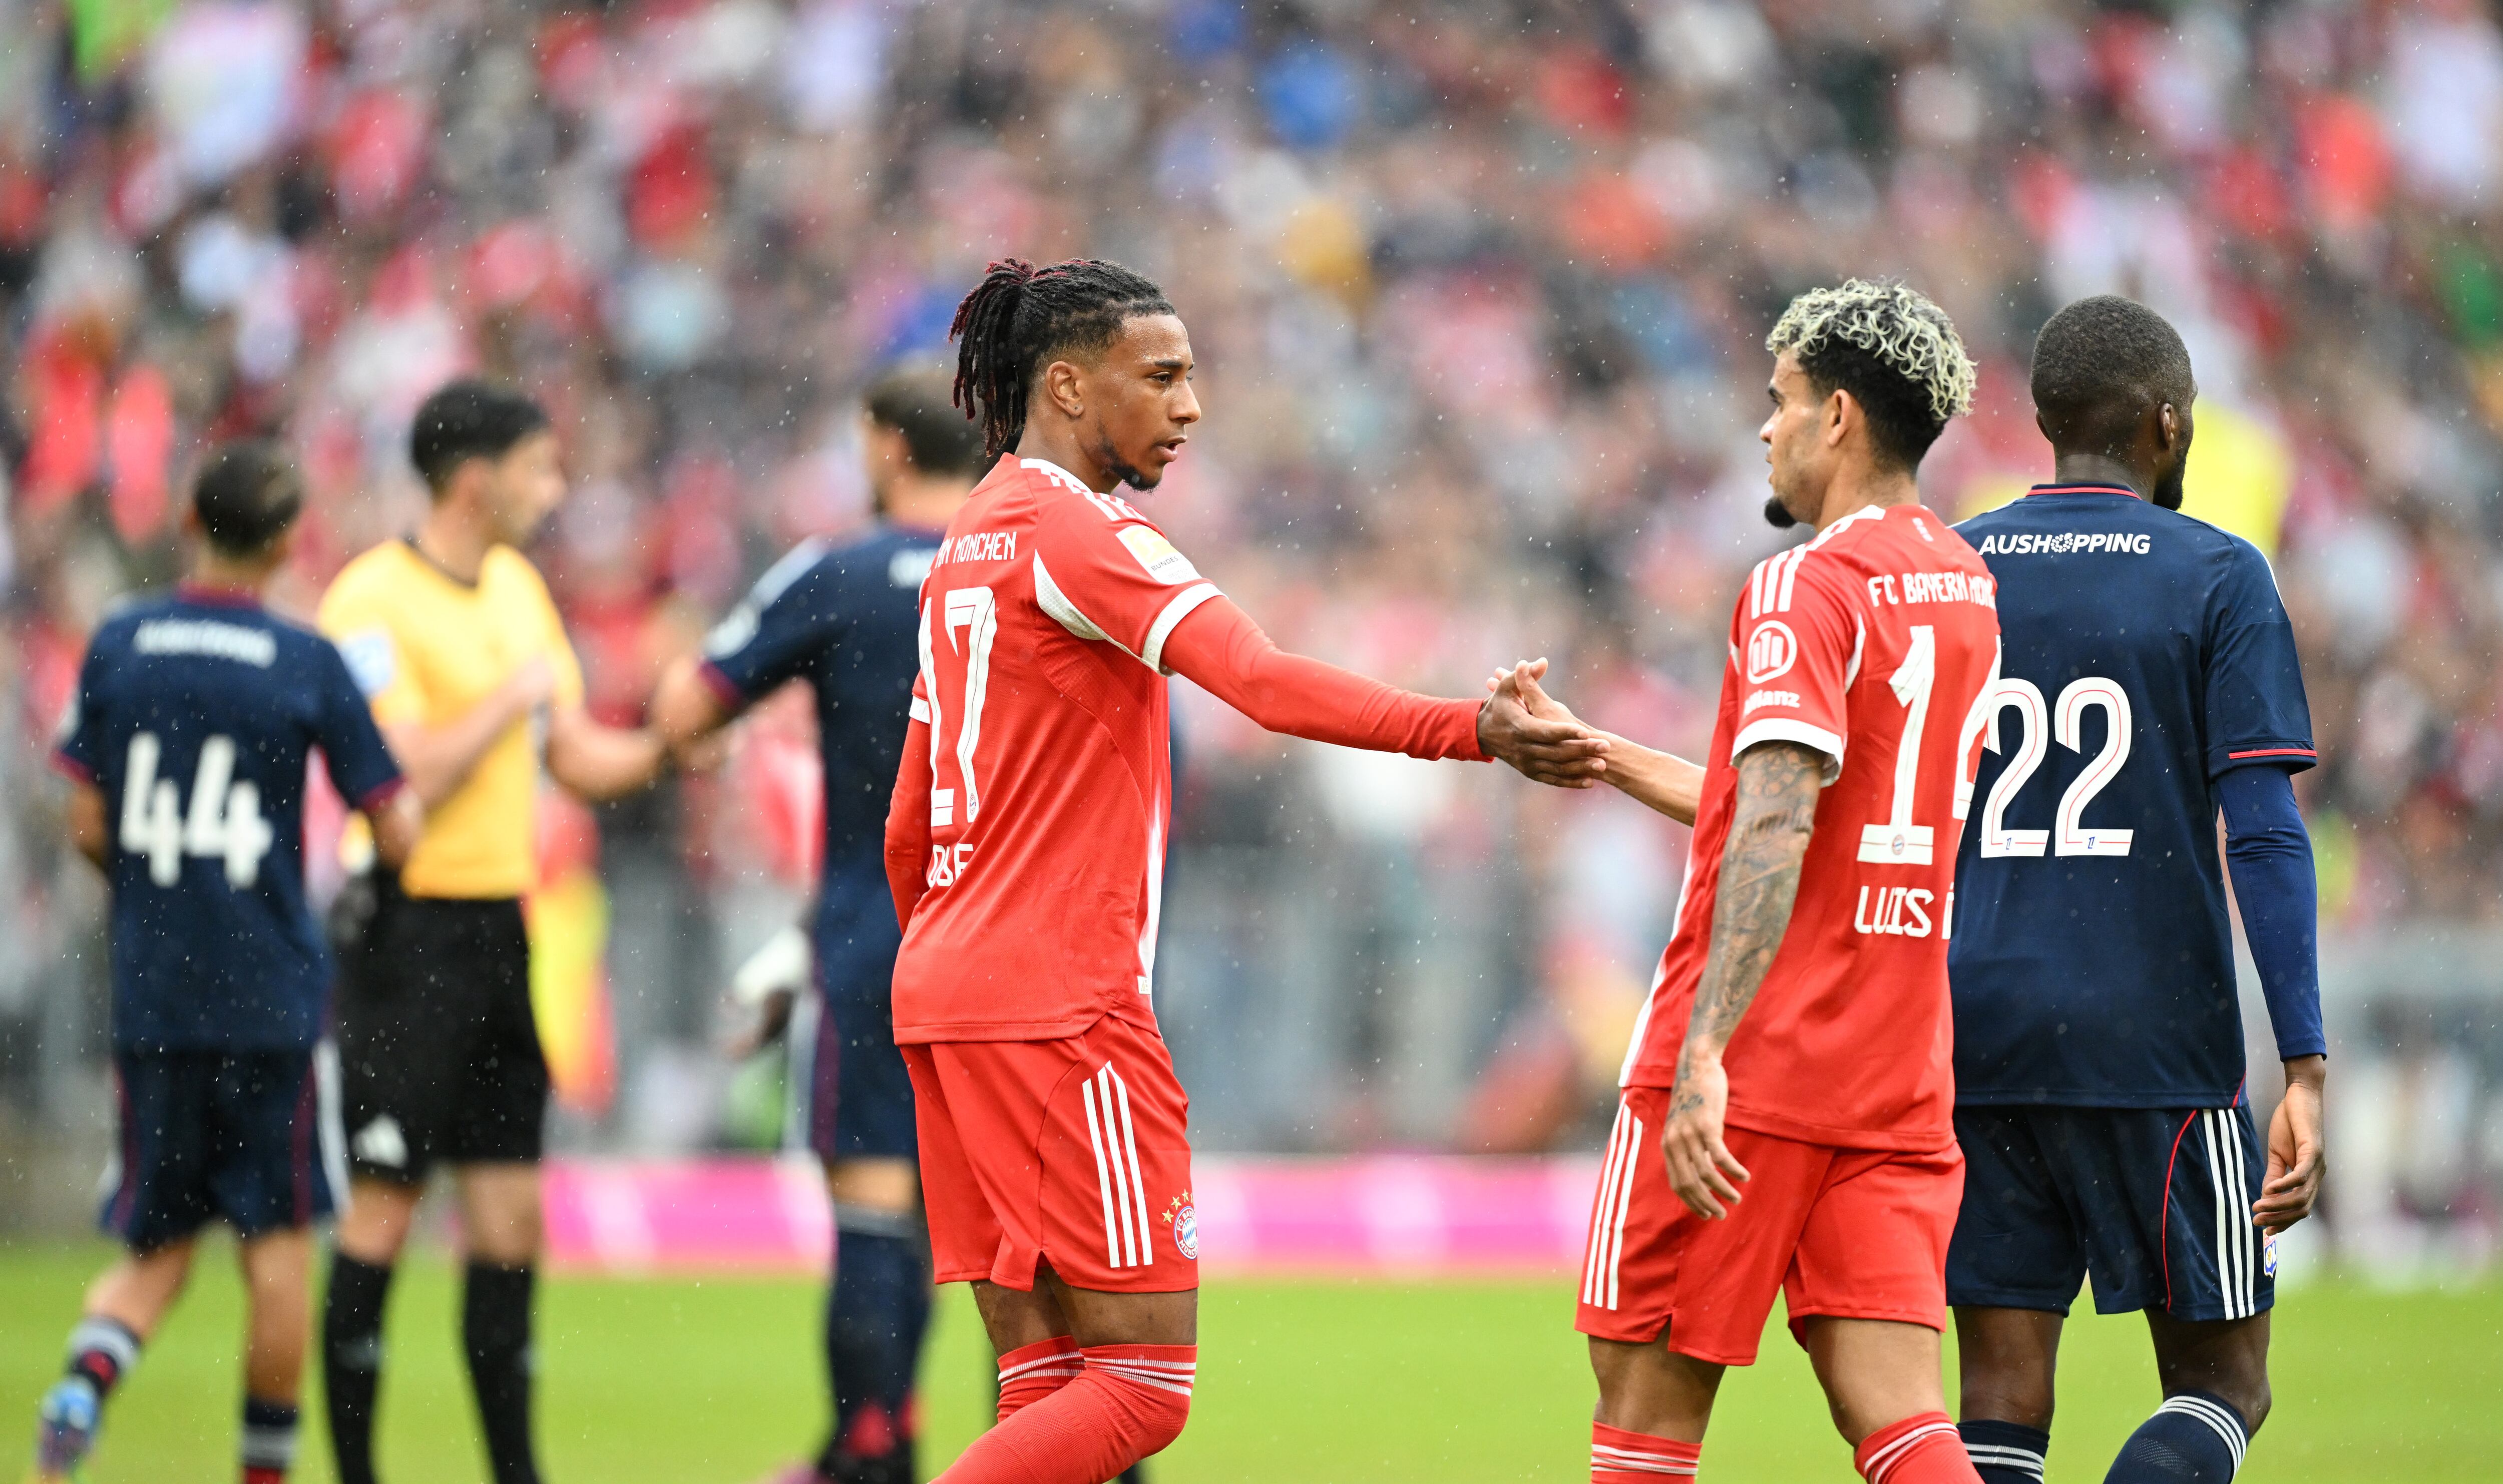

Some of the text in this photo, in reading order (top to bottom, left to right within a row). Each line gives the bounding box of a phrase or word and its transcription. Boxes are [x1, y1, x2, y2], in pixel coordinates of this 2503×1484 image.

[1151, 556, 1179, 571] BUNDES
[1978, 532, 2151, 556] AUSHOPPING
[1867, 575, 1899, 607] FC
[1902, 571, 1970, 604] BAYERN
[918, 586, 996, 826] 17
[1980, 677, 2134, 858] 22
[119, 731, 274, 888] 44
[1854, 885, 1935, 938] LUIS
